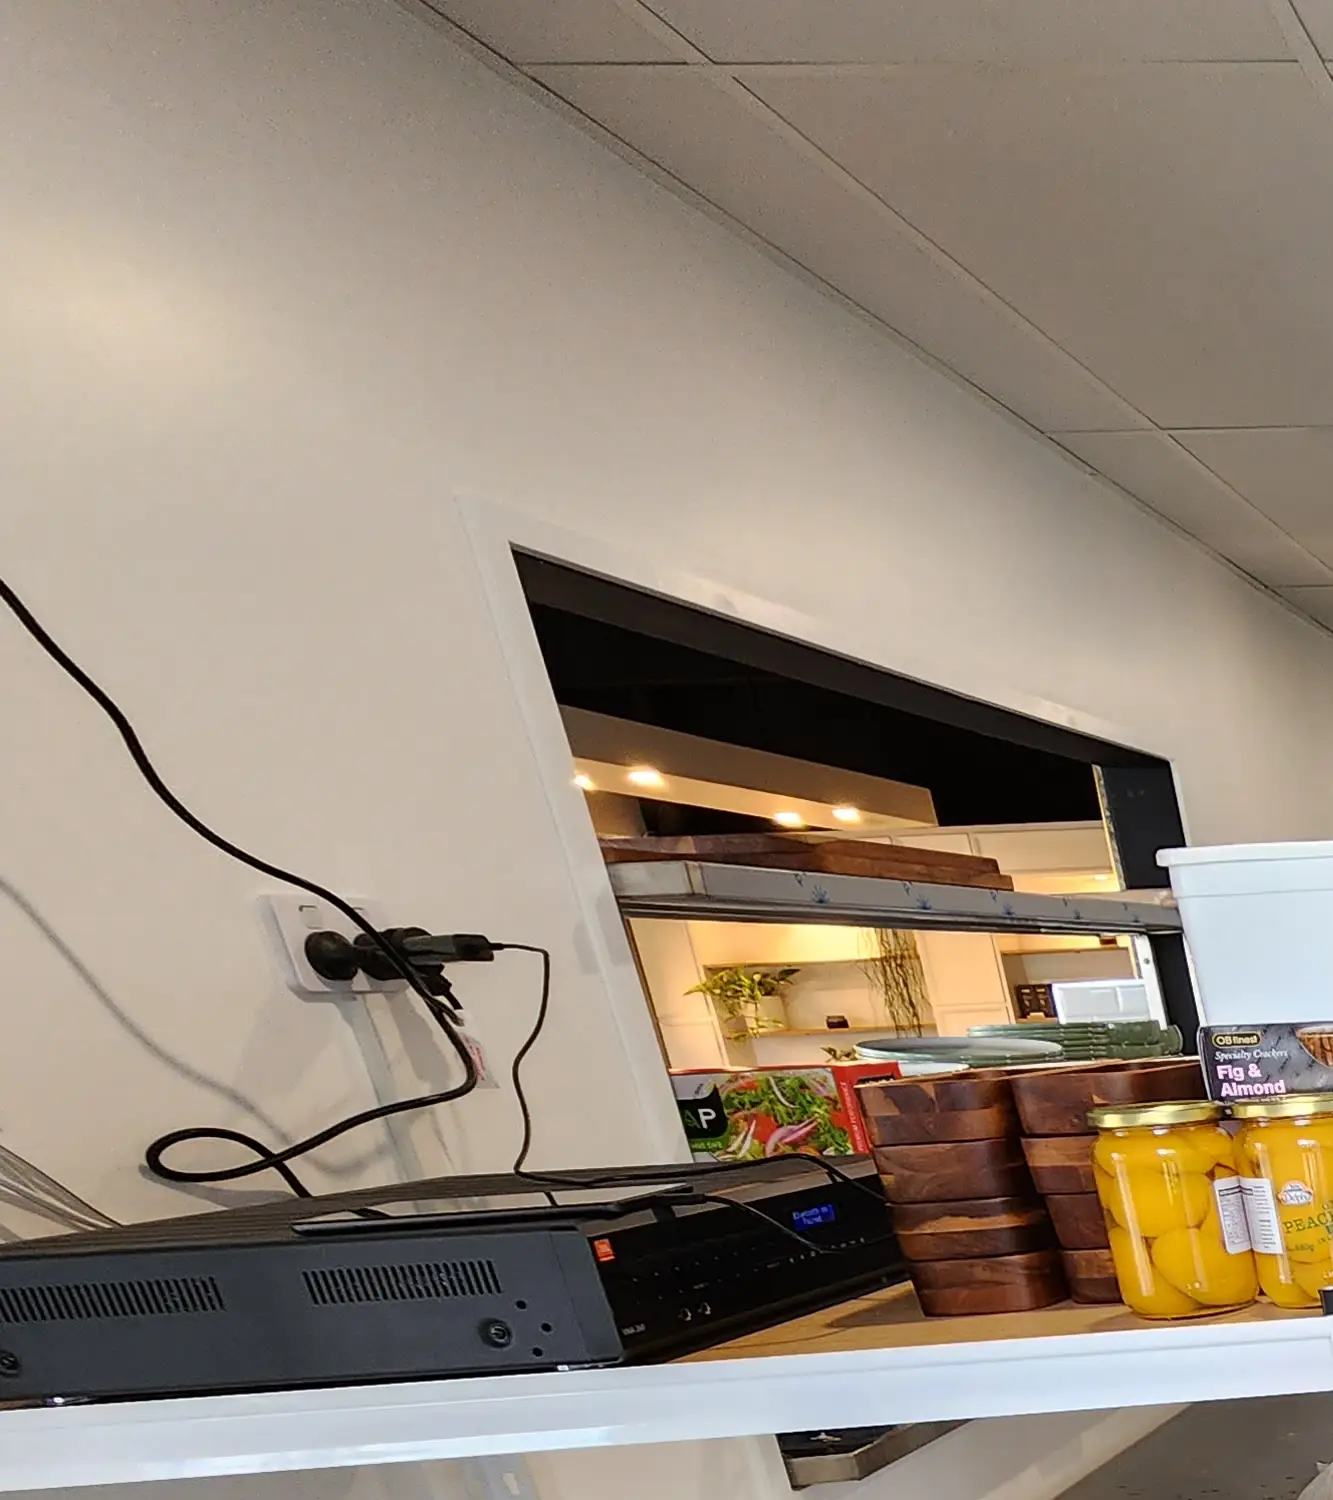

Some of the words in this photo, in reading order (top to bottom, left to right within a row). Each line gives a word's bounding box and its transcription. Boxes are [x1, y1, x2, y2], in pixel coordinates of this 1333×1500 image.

[1216, 1064, 1245, 1081] Fig
[1248, 1063, 1262, 1077] &
[1221, 1079, 1286, 1097] Almond
